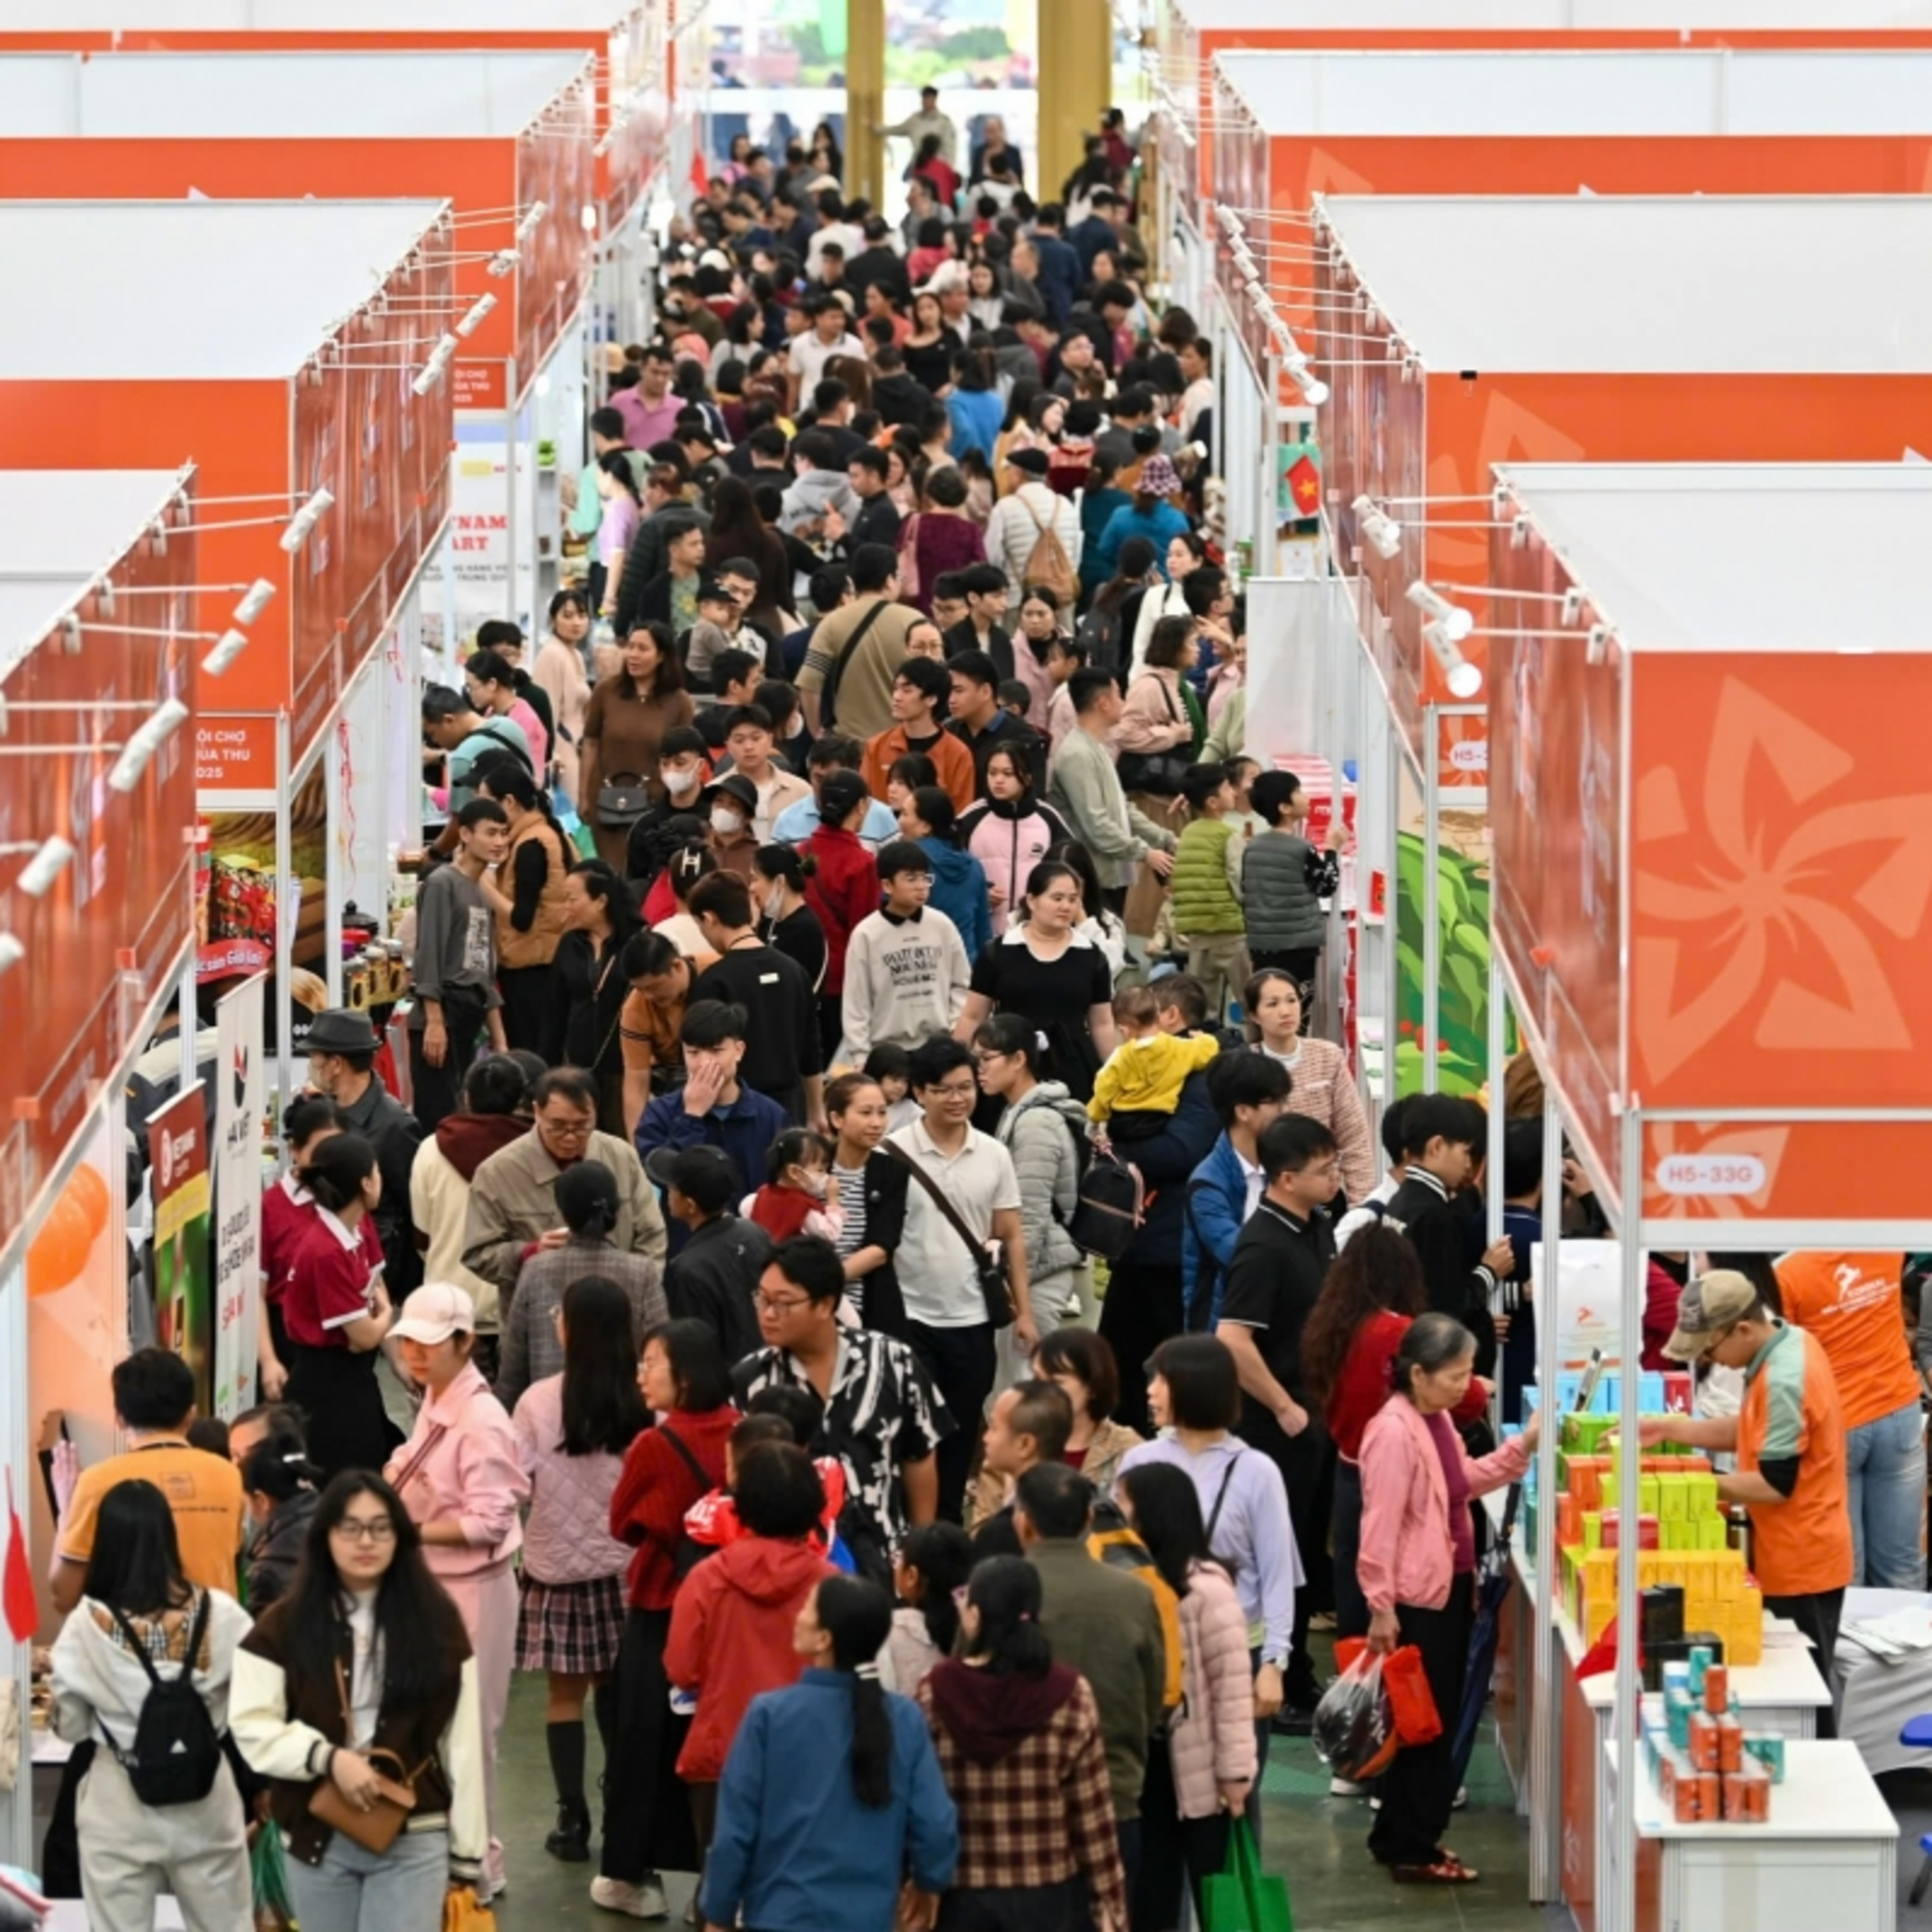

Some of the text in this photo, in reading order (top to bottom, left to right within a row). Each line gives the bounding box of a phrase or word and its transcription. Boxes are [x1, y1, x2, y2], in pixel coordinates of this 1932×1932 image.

[196, 728, 246, 747] ỘI CHỢ
[222, 749, 250, 761] THU
[1454, 750, 1487, 761] H5-
[196, 766, 223, 778] 025
[1669, 1165, 1752, 1184] H5-33G
